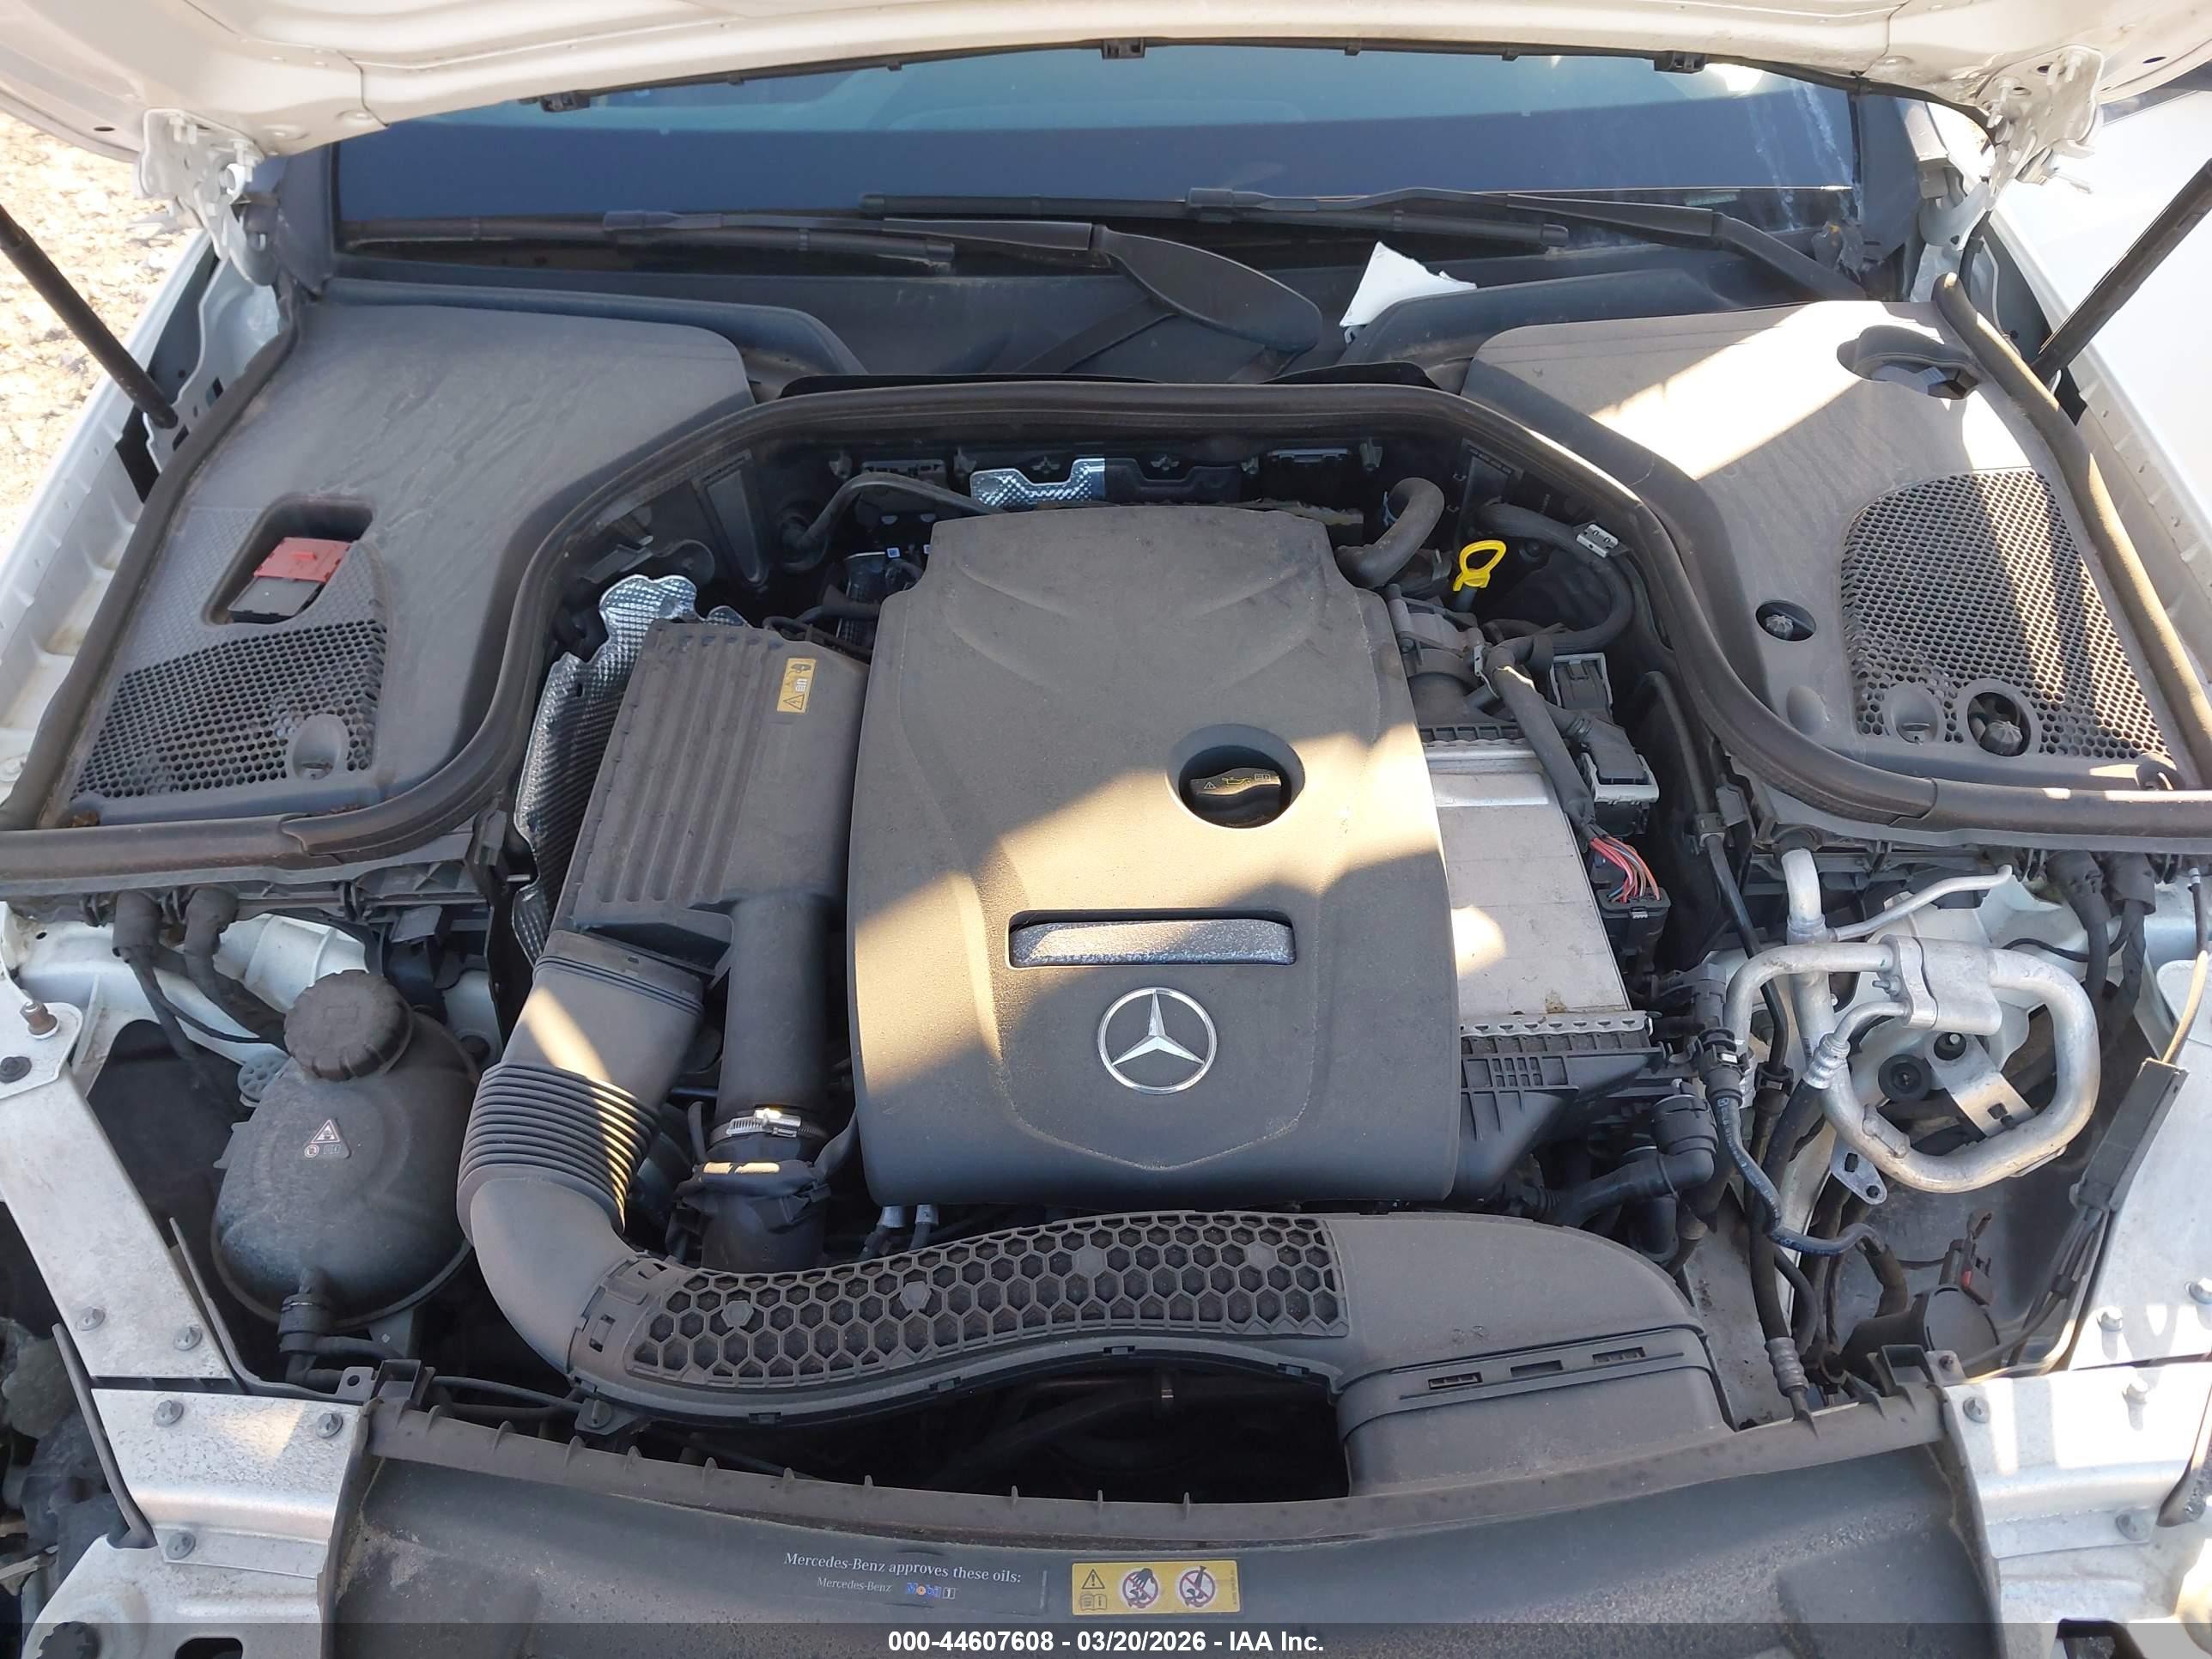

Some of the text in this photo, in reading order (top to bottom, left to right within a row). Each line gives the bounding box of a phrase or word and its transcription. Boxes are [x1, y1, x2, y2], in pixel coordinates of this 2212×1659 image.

[783, 1552, 1022, 1583] Mercedes-Benz approves these oils:
[817, 1577, 892, 1593] Mercedes-Benz
[906, 1582, 942, 1598] Mobil
